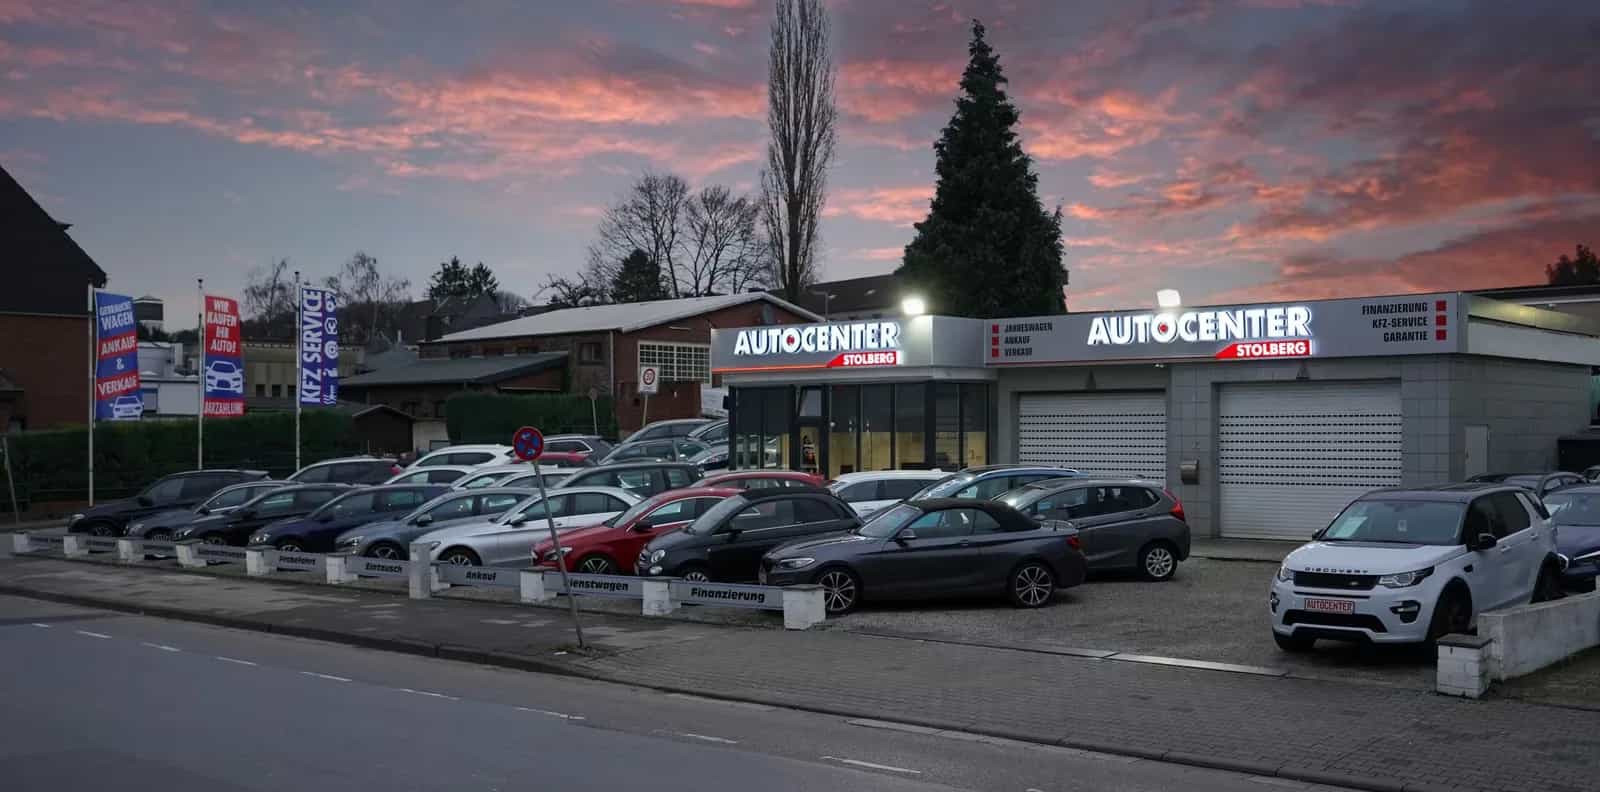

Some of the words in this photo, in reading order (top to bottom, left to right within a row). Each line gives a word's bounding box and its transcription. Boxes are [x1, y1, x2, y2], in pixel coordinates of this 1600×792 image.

[214, 300, 229, 312] WIR
[1362, 302, 1428, 315] FINANZIERUNG
[101, 312, 134, 330] WAGEN
[207, 312, 237, 327] KAUFEN
[1087, 306, 1312, 345] AUTOCENTER
[1372, 317, 1428, 328] KFZ-SERVICE
[216, 326, 229, 338] IHR
[303, 289, 322, 363] SERVICE
[734, 322, 898, 355] AUTOCENTER
[1005, 336, 1030, 344] ANKAUF
[1383, 331, 1428, 342] GARANTIE
[102, 336, 135, 355] ANKAUF
[211, 340, 236, 352] AUTO!
[1236, 342, 1306, 357] STOLBERG
[1005, 348, 1032, 357] VERKAUF
[116, 358, 124, 370] &
[843, 353, 895, 365] STOLBERG
[98, 376, 136, 395] VERKAUF
[301, 367, 321, 403] KFZ
[365, 562, 402, 572] Eintausch
[465, 571, 496, 581] Ankauf
[563, 577, 629, 591] ienstwagen
[691, 587, 765, 603] Finanzierung
[1306, 599, 1352, 611] AUTOCENTER
